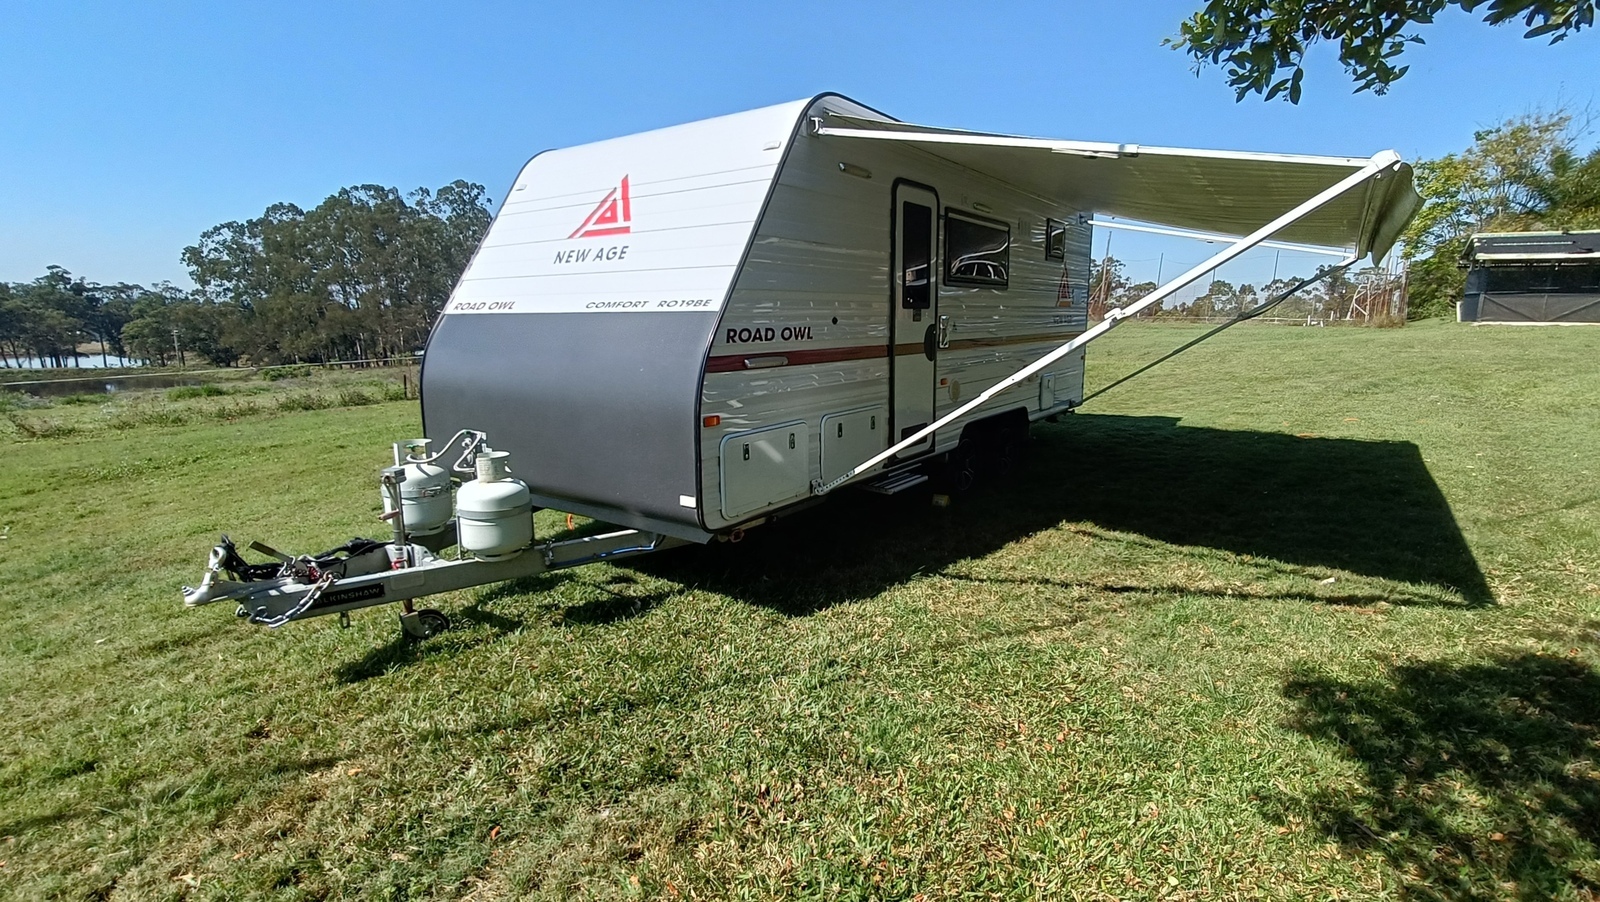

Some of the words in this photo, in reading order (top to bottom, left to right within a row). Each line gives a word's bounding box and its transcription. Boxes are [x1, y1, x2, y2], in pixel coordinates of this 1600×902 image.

[553, 248, 592, 264] NEW
[592, 245, 629, 261] AGE
[453, 302, 487, 311] ROAD
[488, 301, 516, 310] OWL
[585, 301, 649, 309] COMFORT
[656, 299, 713, 308] RO19BE
[726, 327, 776, 344] ROAD
[780, 326, 813, 341] OWL
[313, 587, 380, 604] ALKINSHAW
